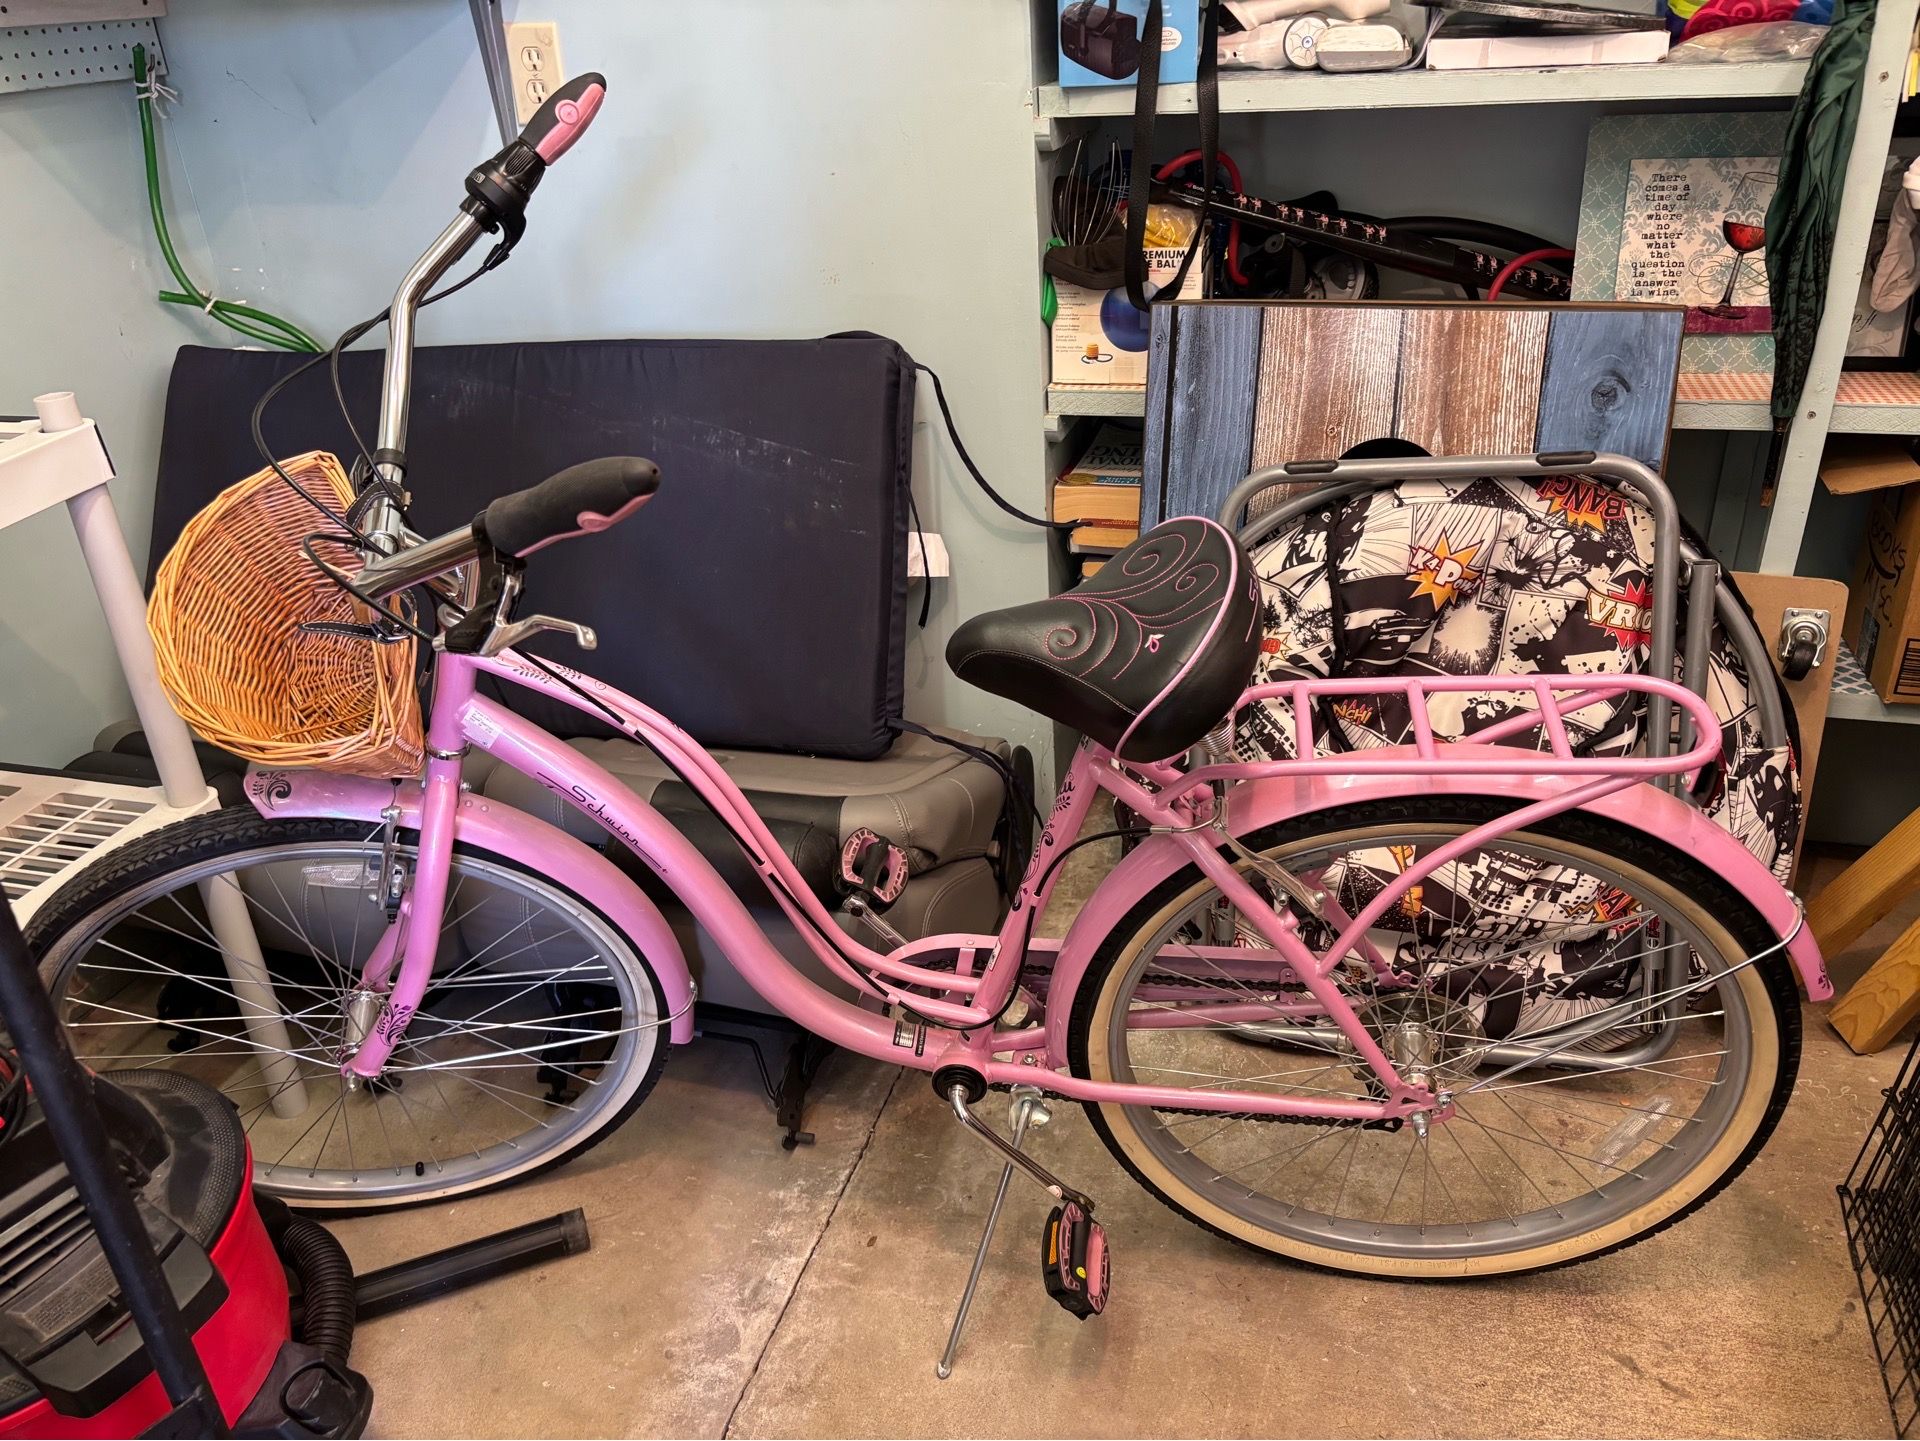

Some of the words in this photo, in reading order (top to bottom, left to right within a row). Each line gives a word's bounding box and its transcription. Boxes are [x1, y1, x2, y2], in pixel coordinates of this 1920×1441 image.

[1651, 173, 1687, 182] There
[1645, 184, 1678, 192] comes
[1683, 183, 1691, 191] a
[1645, 193, 1671, 201] time
[1676, 192, 1690, 201] of
[1654, 202, 1676, 212] day
[1647, 212, 1683, 221] where
[1641, 232, 1683, 240] matter
[1646, 241, 1676, 249] what
[1142, 249, 1186, 260] REMIUM
[1650, 250, 1671, 259] the
[1631, 259, 1685, 271] question
[1632, 268, 1645, 278] is
[1662, 269, 1682, 278] the
[1634, 279, 1678, 287] answer
[1630, 286, 1643, 296] is
[1648, 286, 1680, 296] wine.
[1331, 703, 1373, 724] NCH!
[571, 784, 639, 846] Schwinn
